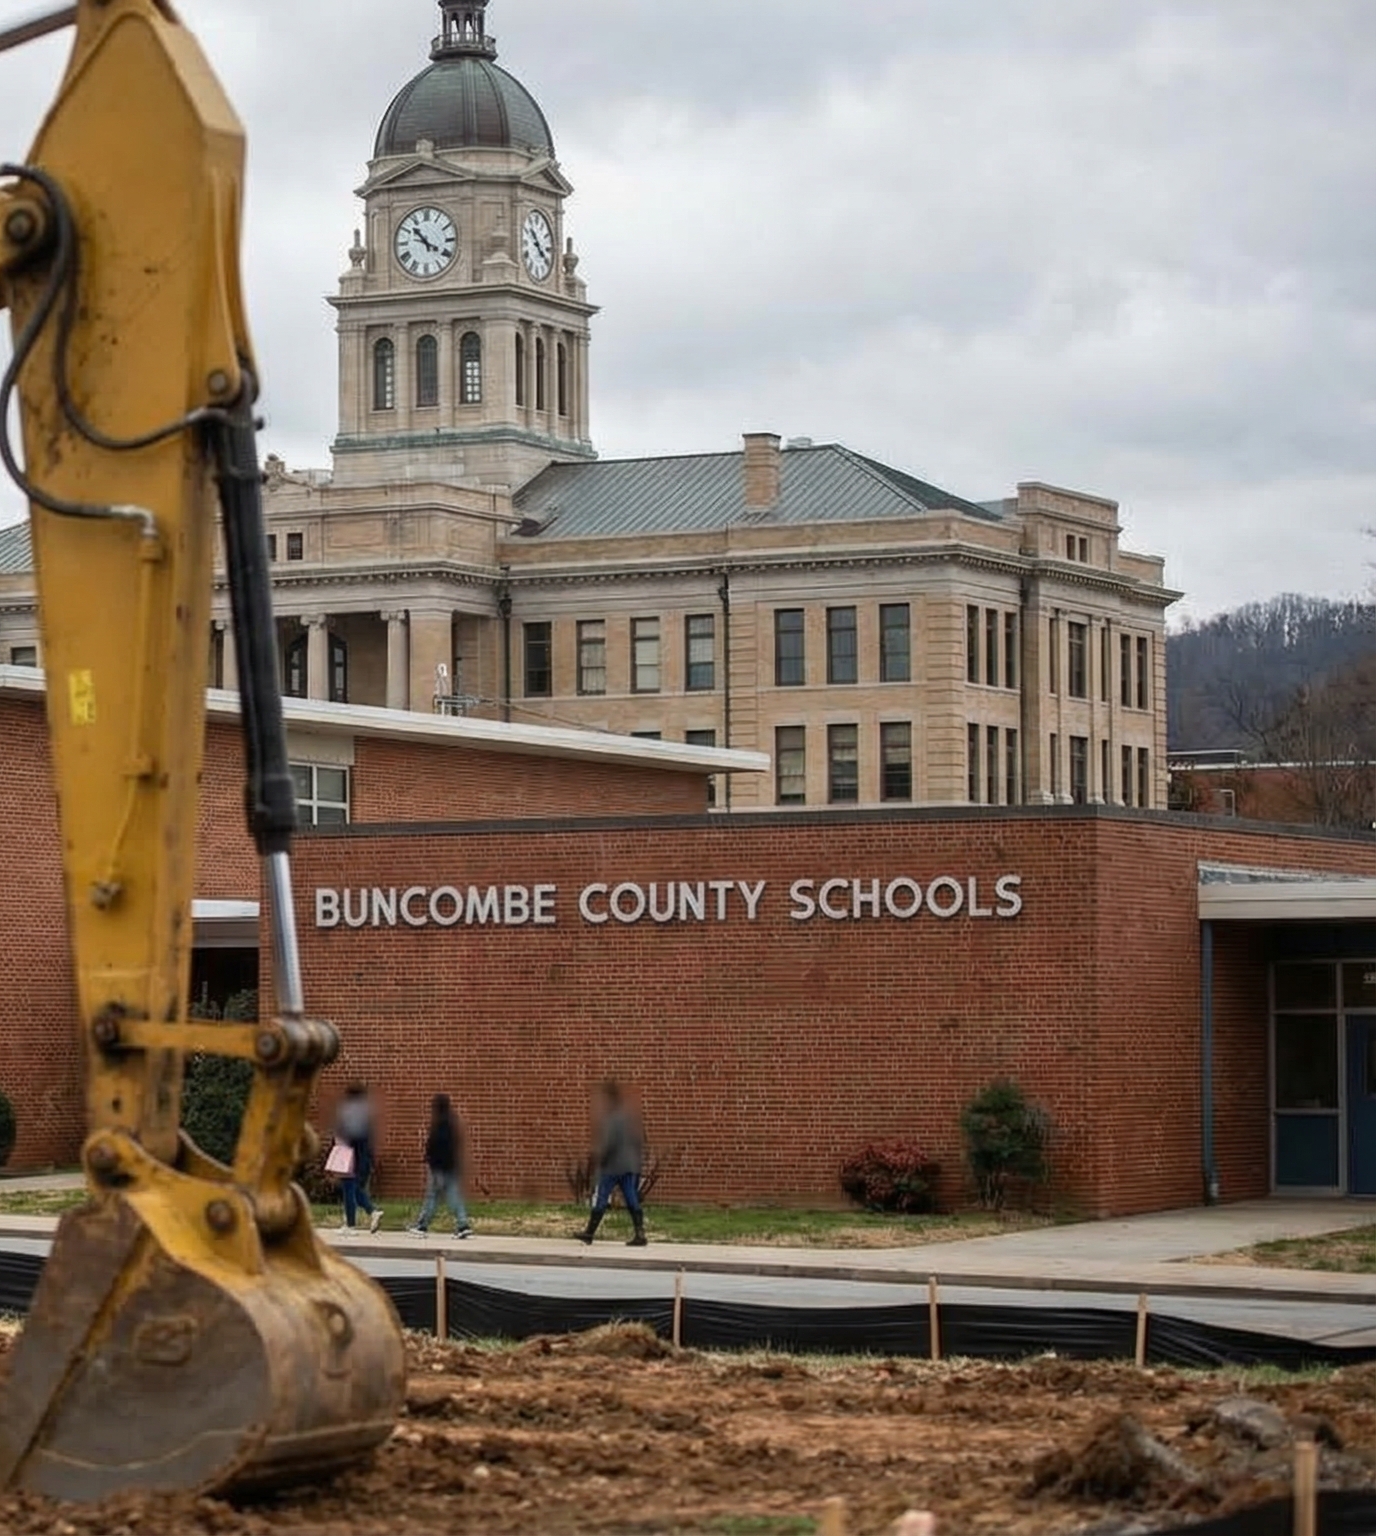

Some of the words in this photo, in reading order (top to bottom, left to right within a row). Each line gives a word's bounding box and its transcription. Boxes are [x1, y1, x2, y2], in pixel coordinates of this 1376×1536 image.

[315, 884, 556, 928] BUNCOMBE
[579, 879, 766, 923] COUNTY
[789, 875, 1023, 920] SCHOOLS
